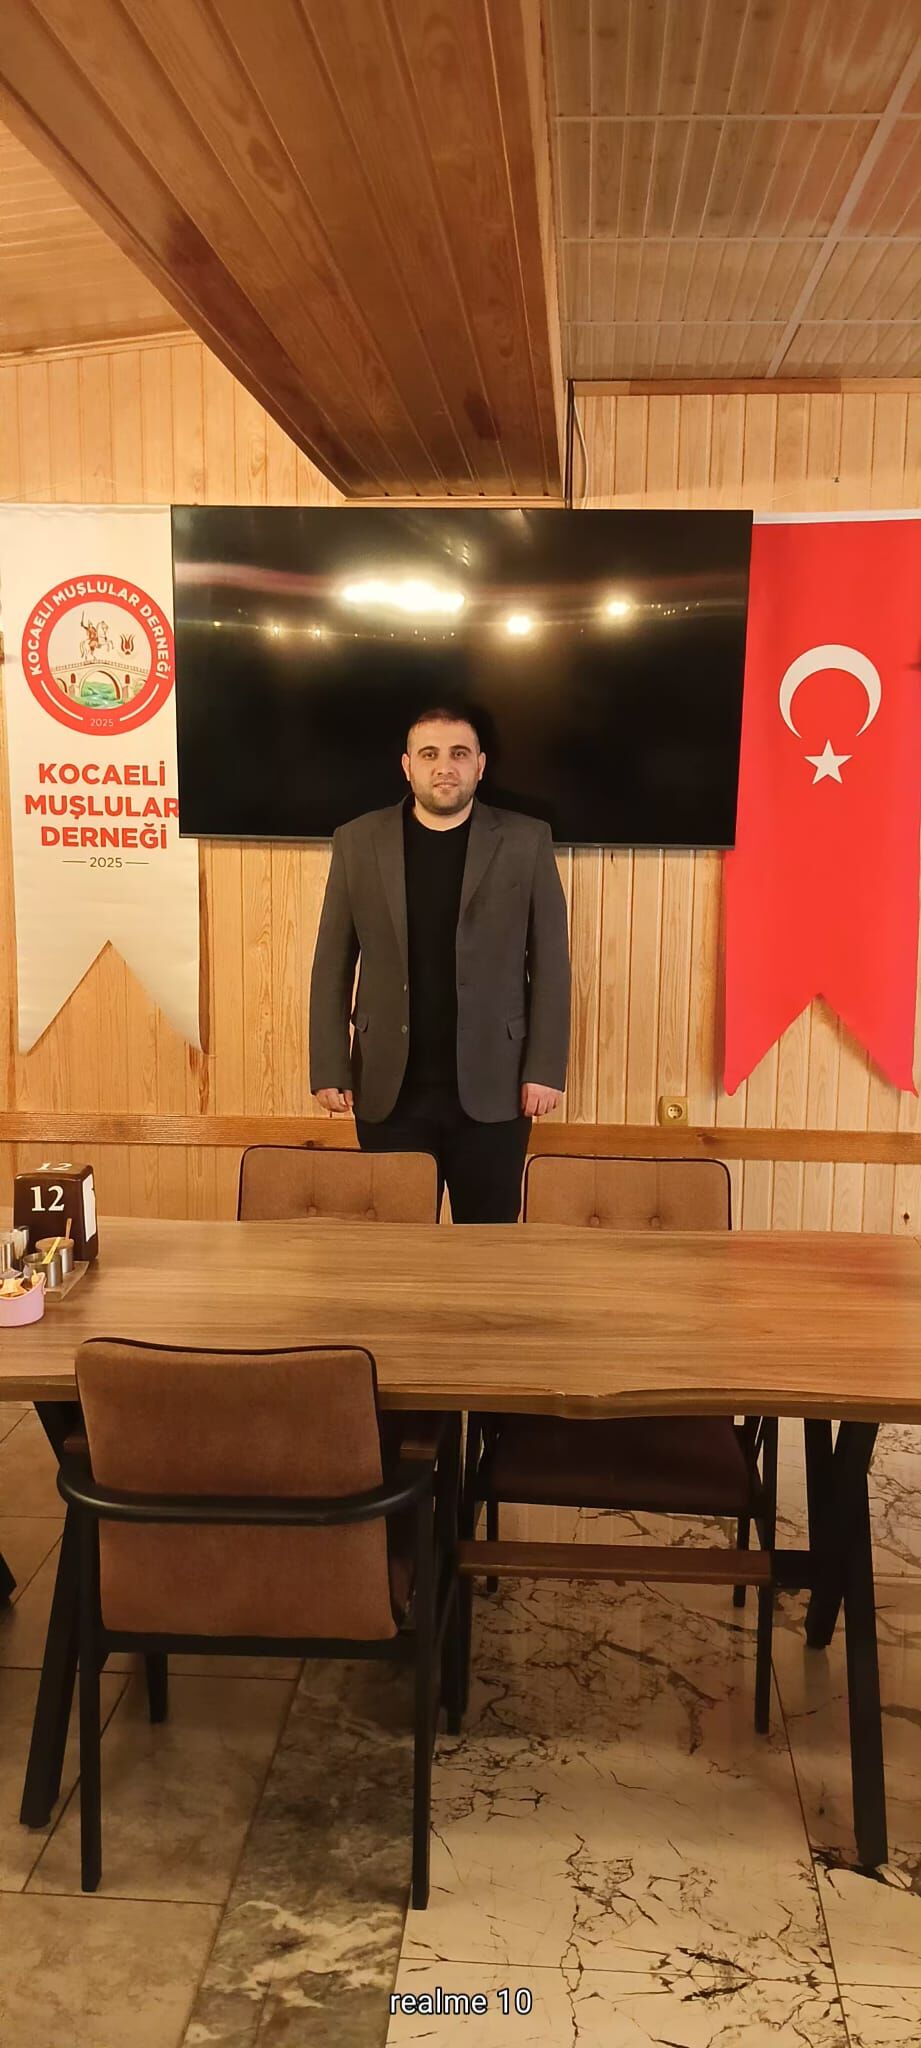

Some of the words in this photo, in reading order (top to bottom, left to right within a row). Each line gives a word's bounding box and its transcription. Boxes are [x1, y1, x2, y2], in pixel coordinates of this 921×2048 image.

[52, 580, 141, 607] MUŞLULAR
[90, 718, 114, 727] 2025
[38, 760, 166, 786] KOCAELİ
[24, 794, 179, 820] MUŞLULAR
[40, 822, 167, 849] DERNEĞİ
[89, 856, 123, 868] 2025
[36, 1162, 73, 1171] 12
[30, 1185, 65, 1212] 12
